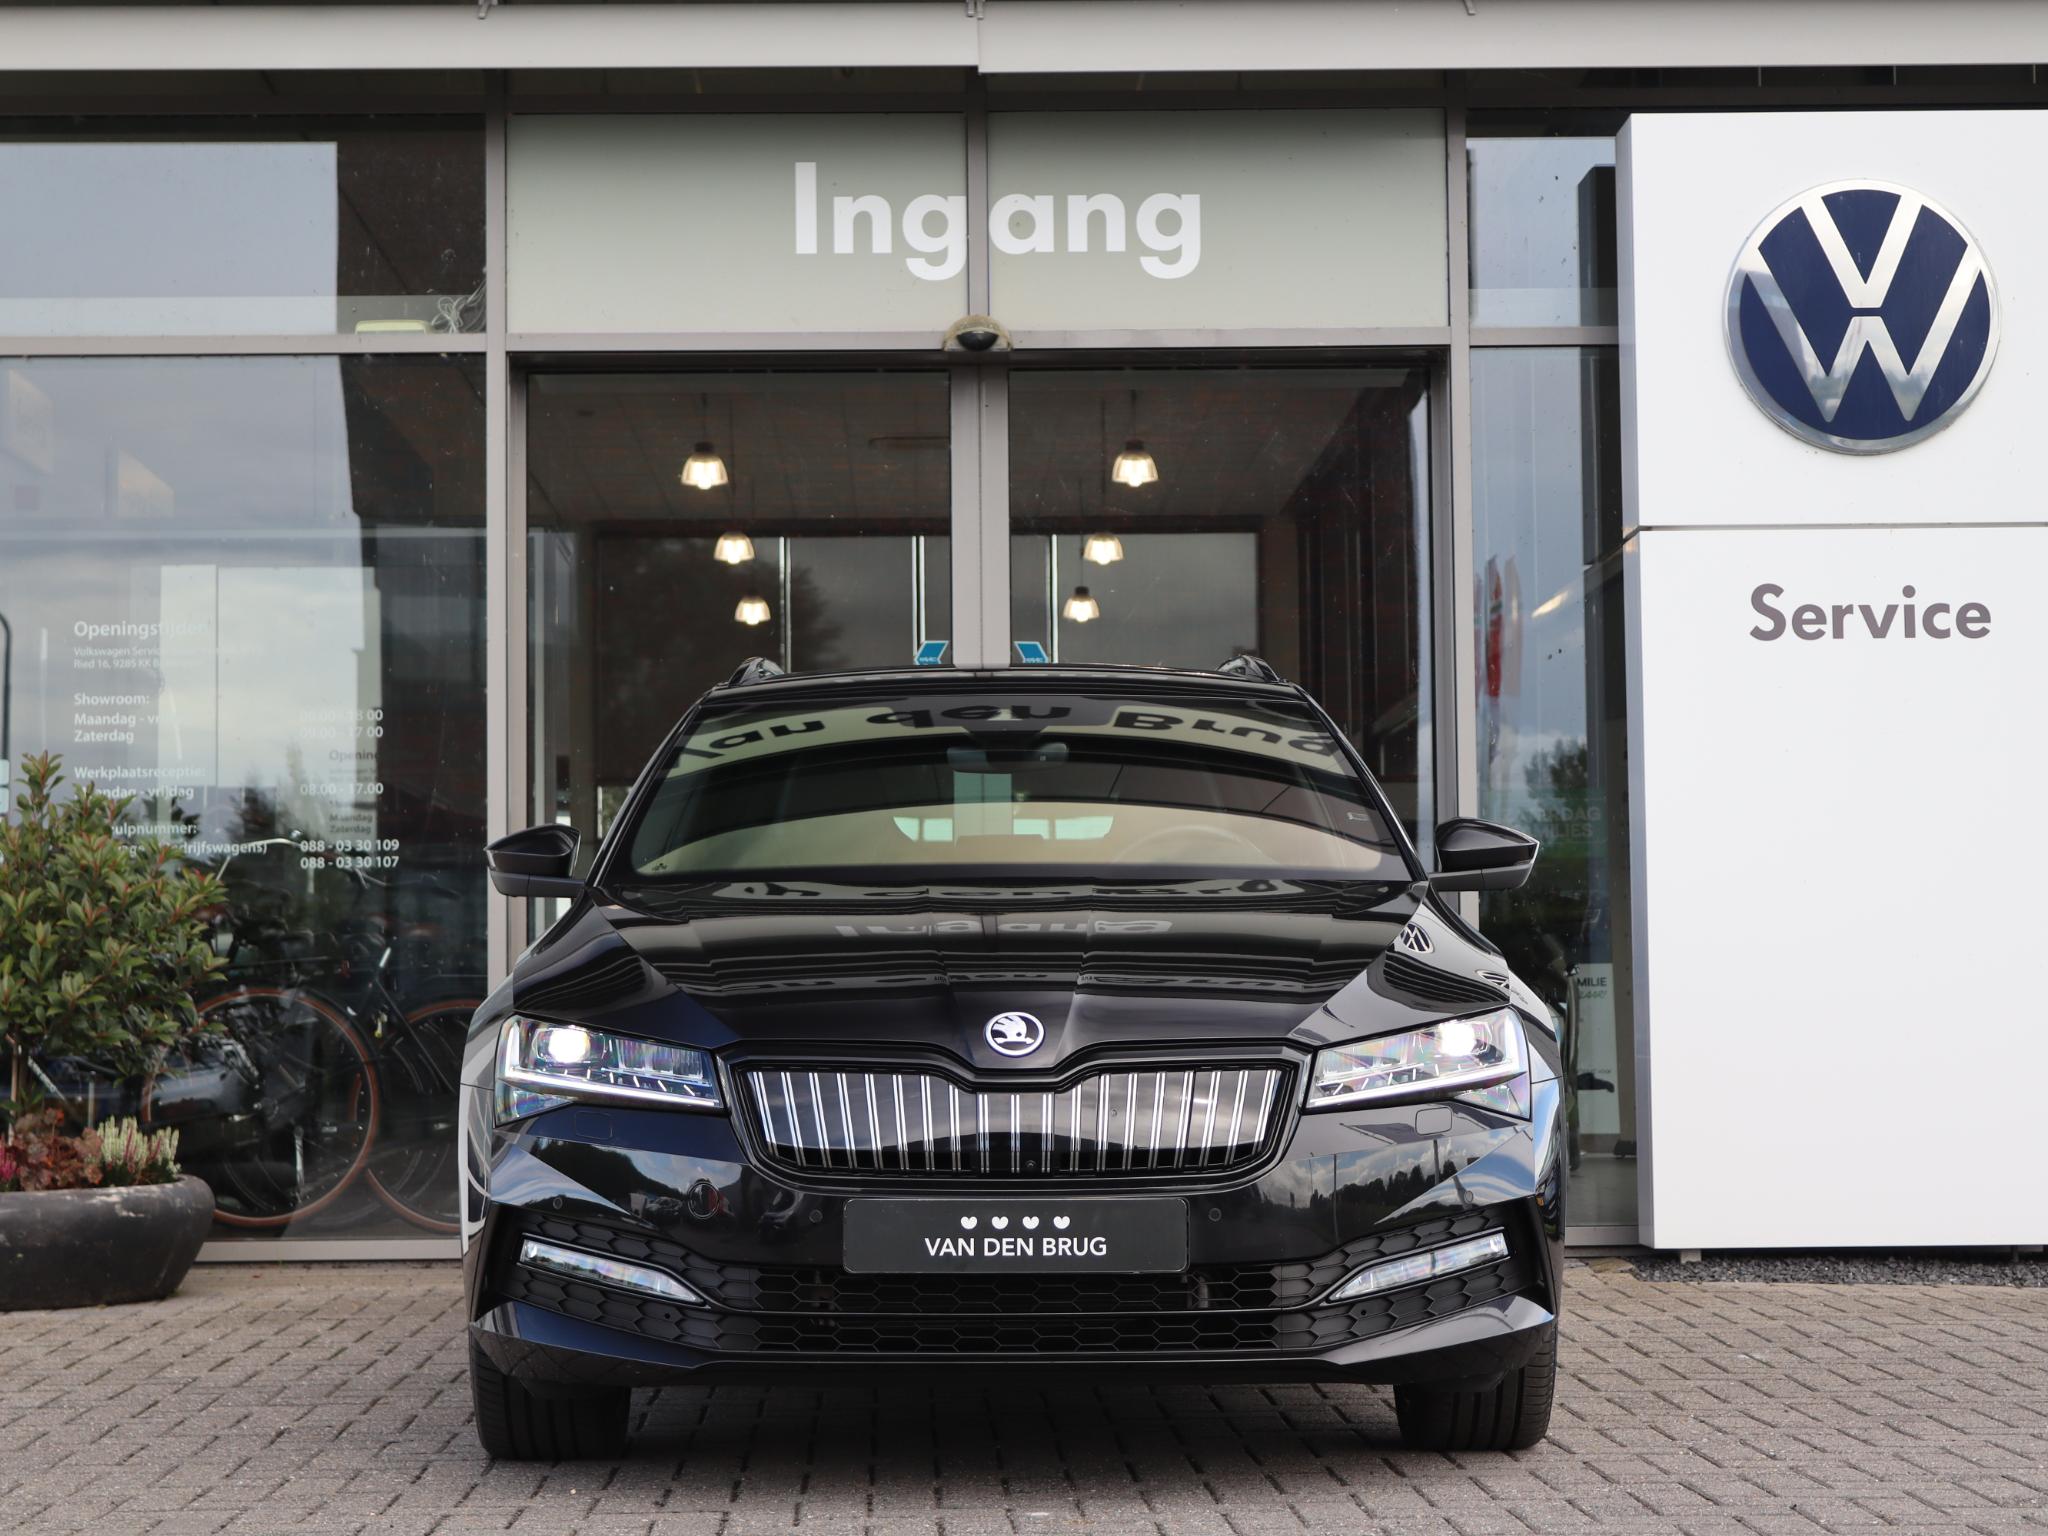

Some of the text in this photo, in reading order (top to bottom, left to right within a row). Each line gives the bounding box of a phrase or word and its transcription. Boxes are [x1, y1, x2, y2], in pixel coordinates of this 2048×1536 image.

[795, 162, 1201, 280] Ingang
[1750, 583, 1992, 641] Service
[74, 693, 150, 705] Showroom:
[74, 712, 136, 728] Maandag
[74, 729, 134, 744] Zaterdag
[112, 822, 197, 837] ulpnummer:
[300, 840, 325, 852] 088
[336, 840, 352, 851] 03
[356, 840, 372, 851] 30
[376, 839, 399, 851] 109
[300, 857, 325, 869] 088
[336, 857, 352, 868] 03
[356, 857, 372, 868] 30
[376, 856, 399, 868] 107
[925, 1237, 1107, 1256] VAN DEN BRUG
